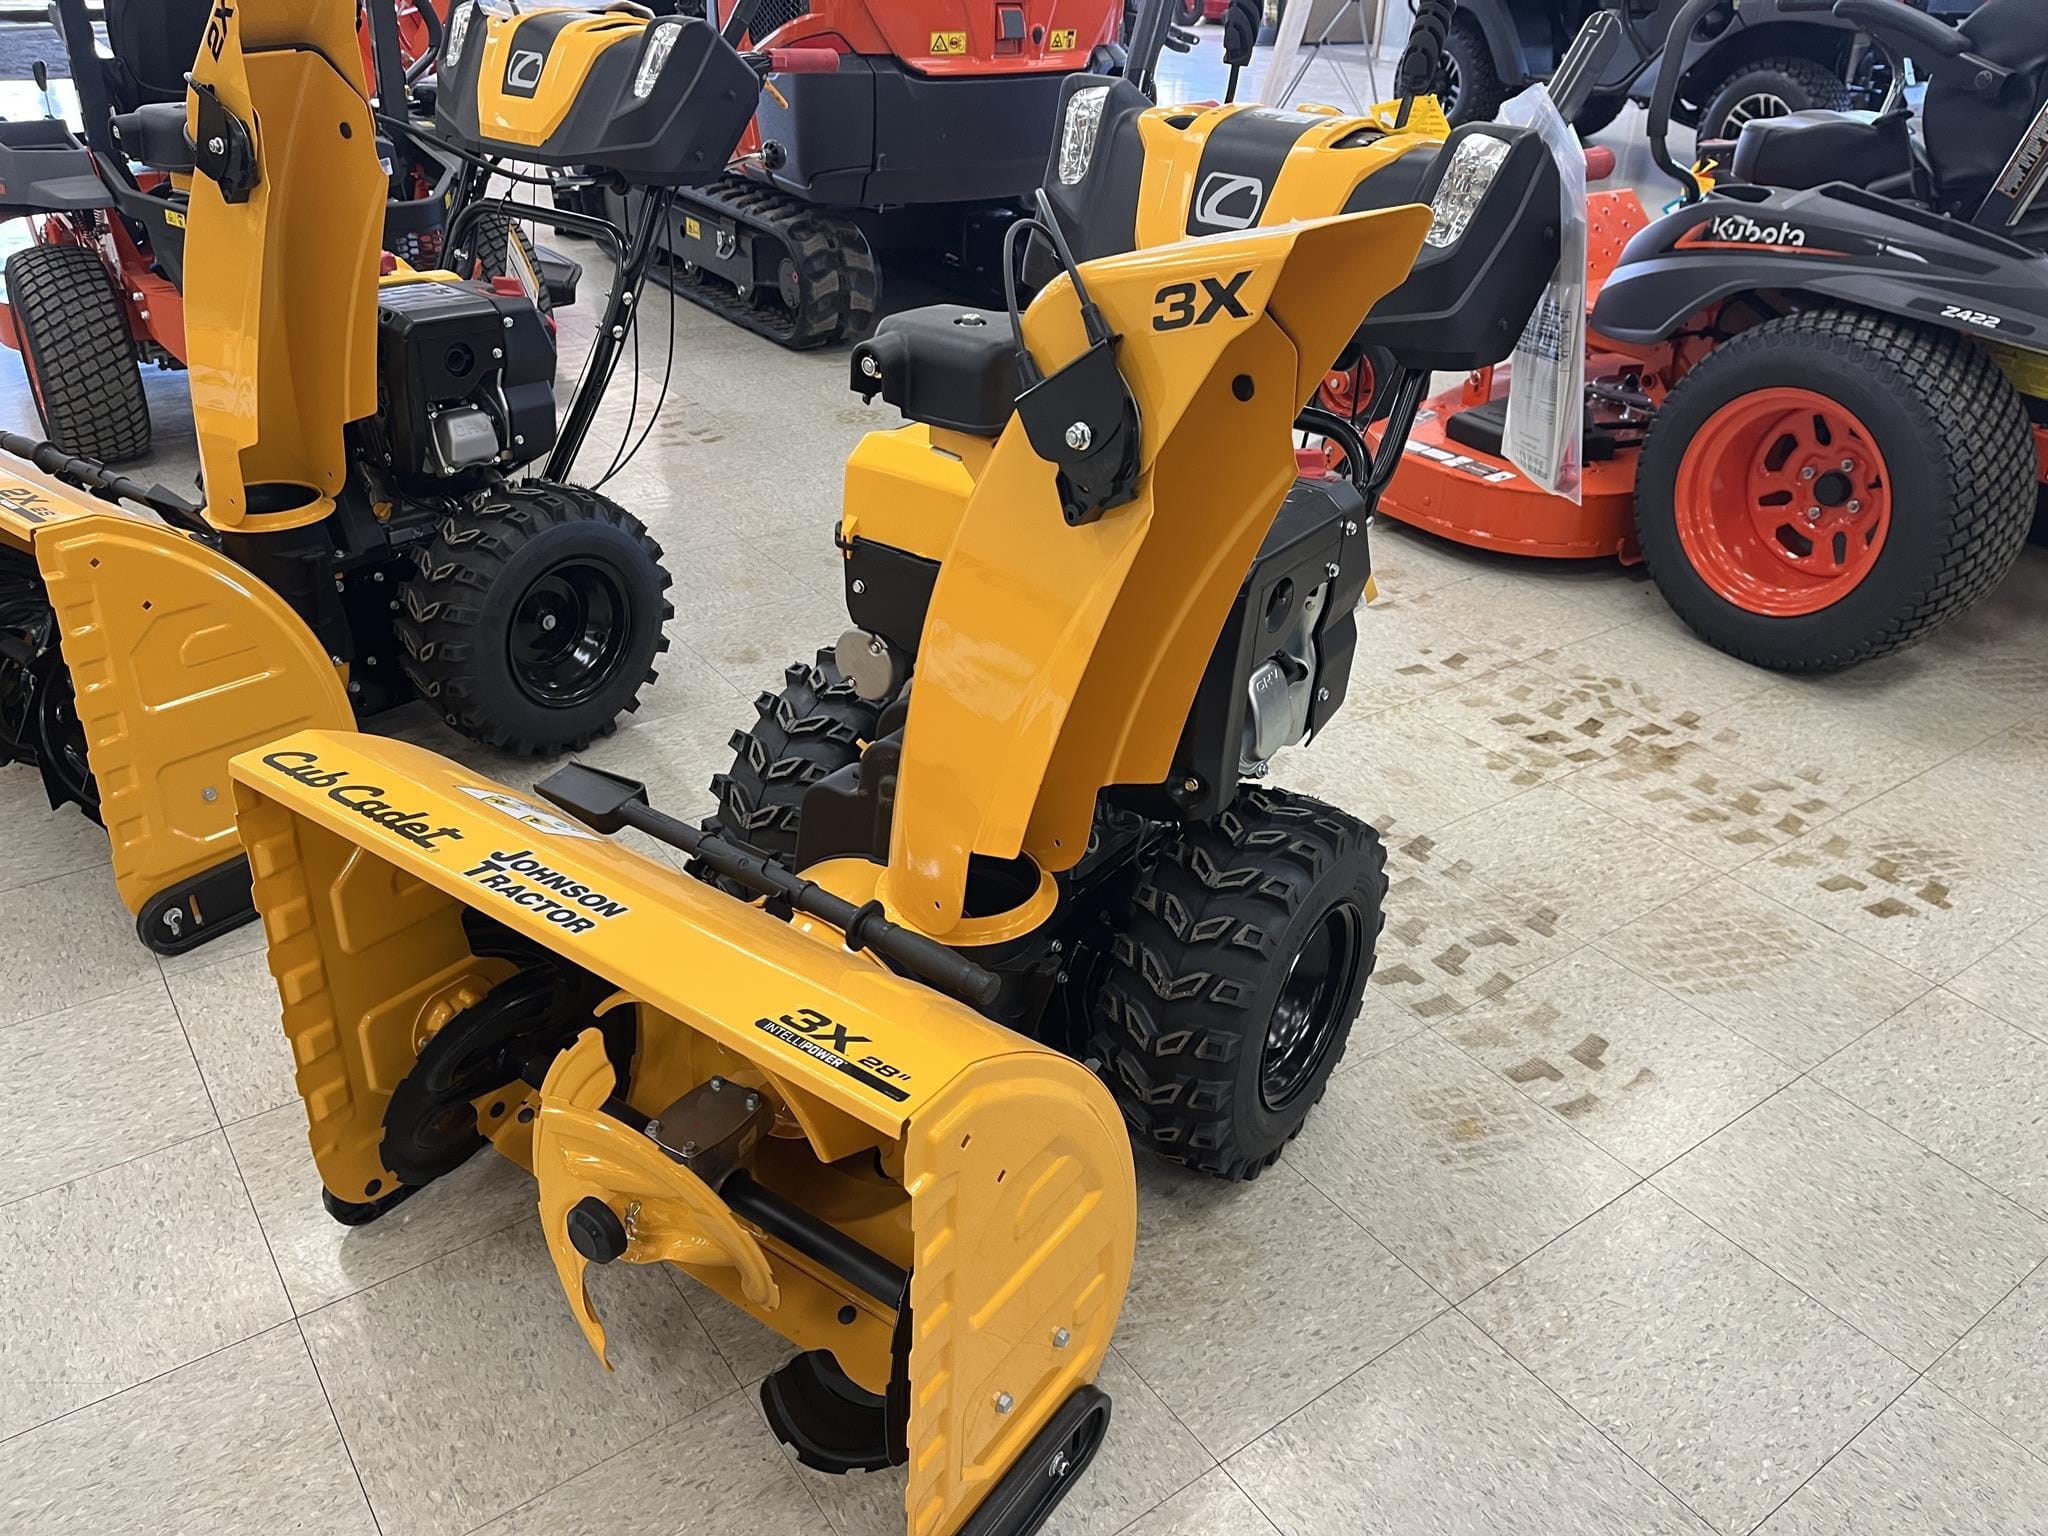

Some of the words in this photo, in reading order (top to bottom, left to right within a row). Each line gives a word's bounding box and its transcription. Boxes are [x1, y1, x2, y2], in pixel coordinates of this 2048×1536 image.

[1712, 215, 1805, 247] Kubota
[1153, 270, 1254, 331] 3X
[1940, 305, 2001, 328] Z422
[262, 752, 350, 788] Cub
[328, 785, 464, 849] Cadet
[463, 859, 596, 934] TRACTOR
[490, 850, 628, 918] JOHNSON
[763, 1021, 848, 1068] INTELLIPOWER
[779, 1008, 873, 1055] 3X
